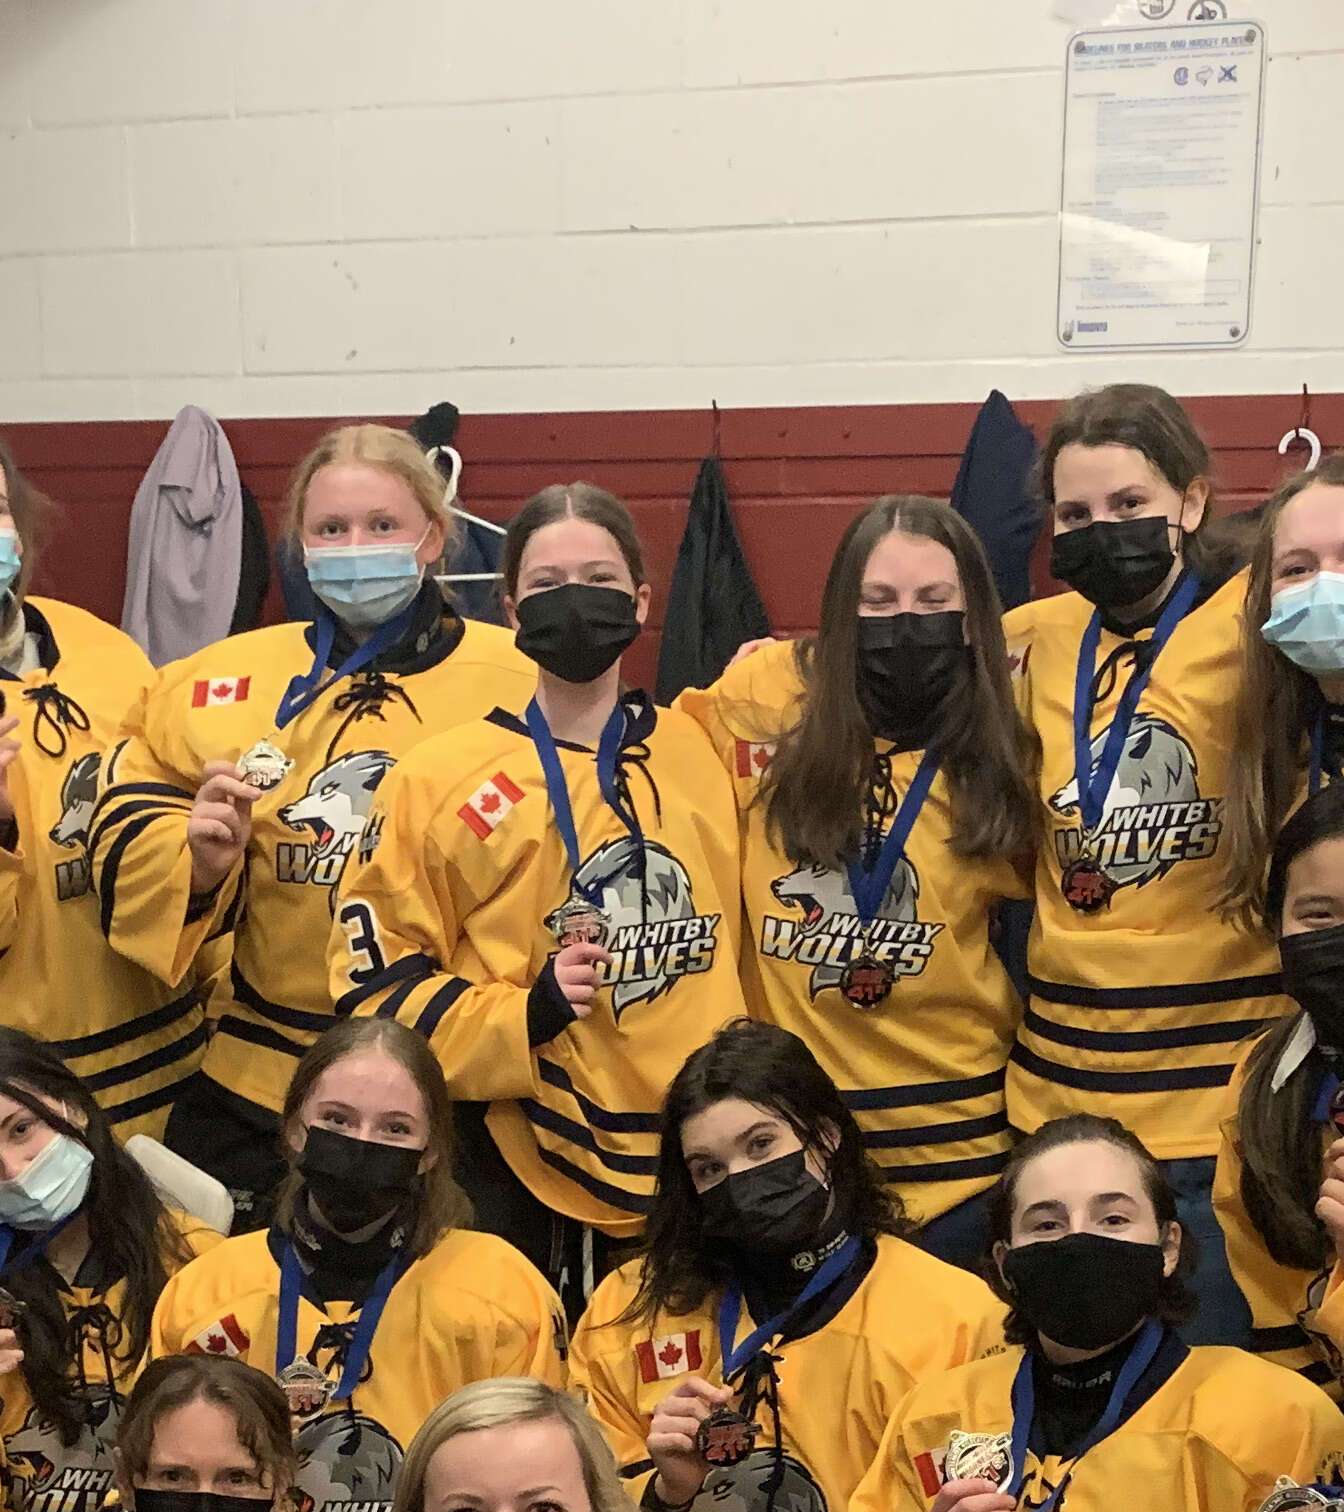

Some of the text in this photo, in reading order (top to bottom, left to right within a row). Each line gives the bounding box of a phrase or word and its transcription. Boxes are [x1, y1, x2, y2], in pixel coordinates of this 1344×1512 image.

[1110, 798, 1224, 831] WHITBY
[339, 900, 388, 985] 3
[613, 914, 721, 951] WHITBY
[549, 938, 716, 988] OLVES
